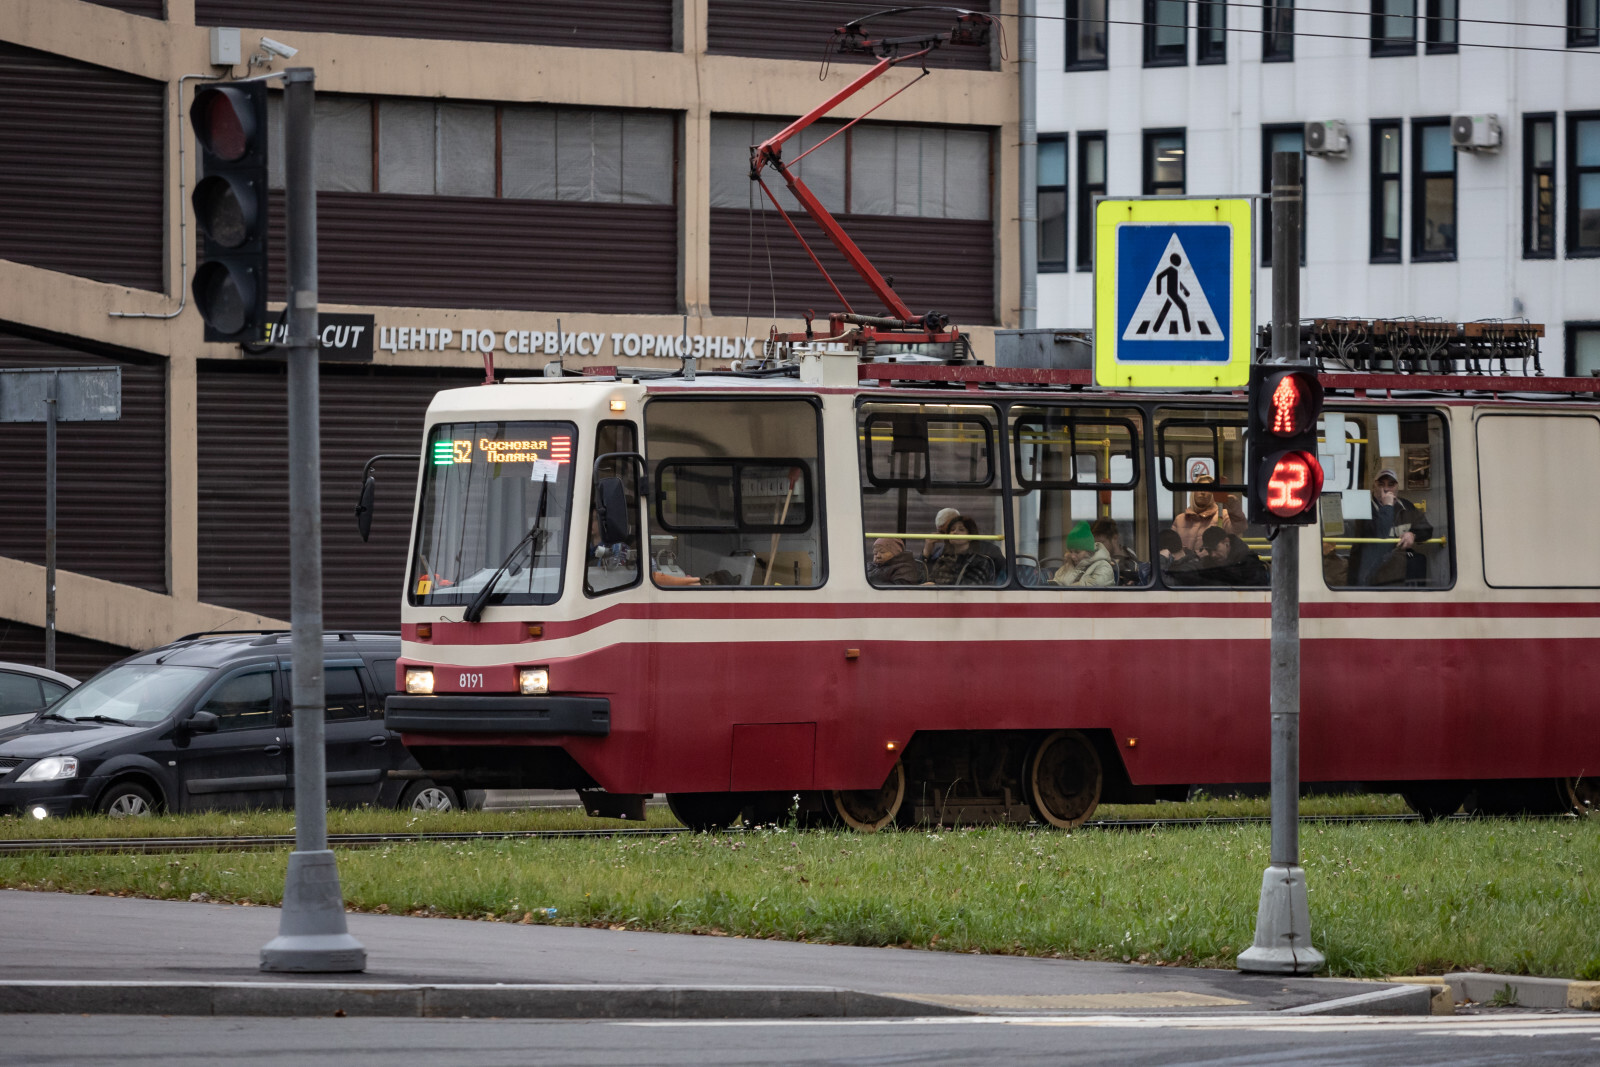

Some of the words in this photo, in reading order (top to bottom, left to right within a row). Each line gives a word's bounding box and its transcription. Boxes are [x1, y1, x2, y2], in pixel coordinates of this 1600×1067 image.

[379, 326, 453, 354] ЦЕНТР
[461, 329, 496, 353] ПО
[504, 329, 605, 356] СЕРВИСУ
[611, 332, 756, 359] ТОРМОЗНЫХ
[453, 440, 472, 463] 52
[479, 438, 548, 451] Сосновая
[487, 450, 538, 463] Поляна
[1267, 462, 1307, 507] 52
[459, 673, 484, 688] 8191
